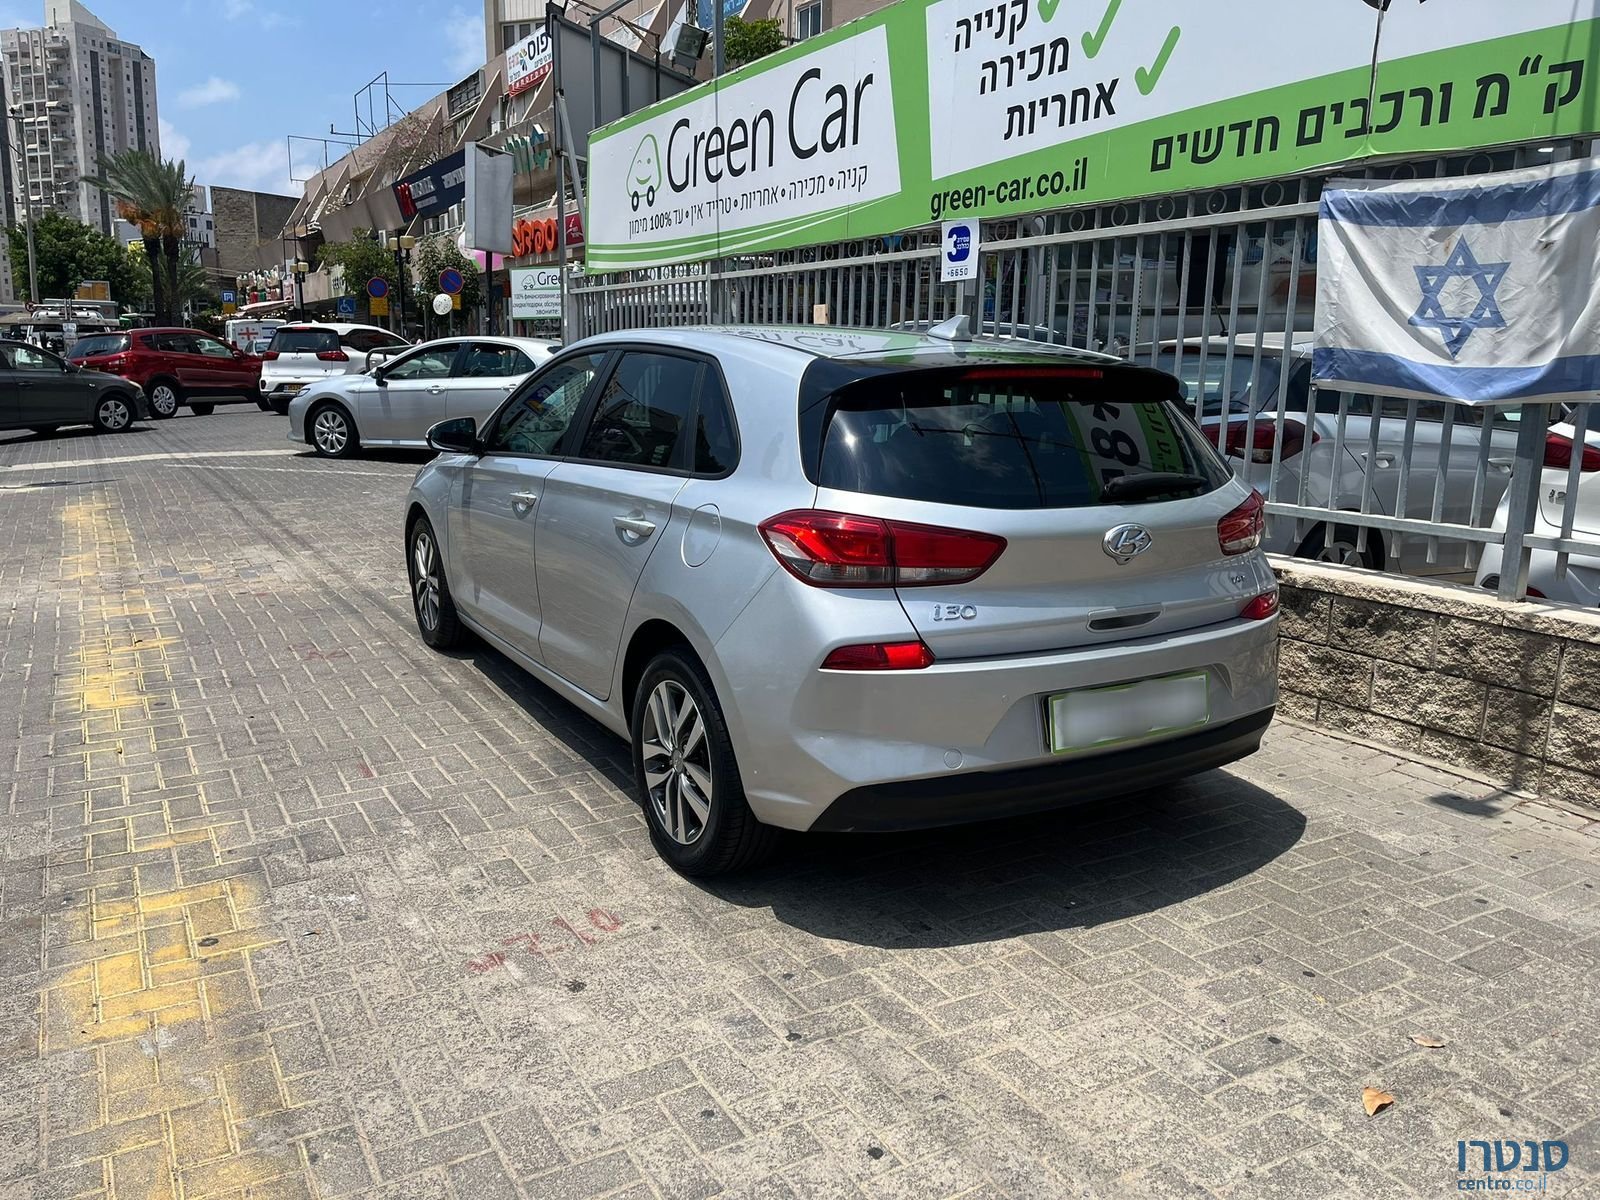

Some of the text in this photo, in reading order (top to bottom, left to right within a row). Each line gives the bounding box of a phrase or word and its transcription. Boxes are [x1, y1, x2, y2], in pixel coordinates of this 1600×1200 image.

[954, 0, 1028, 52] קנייה
[980, 37, 1069, 95] מכירה
[667, 67, 873, 193] Green Car
[1003, 78, 1119, 141] אחריות
[1296, 82, 1453, 148] ורכבים
[1150, 115, 1280, 172] חדשים
[629, 165, 867, 239] קניה מכירה אחריות טרייד אין עד 100% מימון
[930, 157, 1088, 220] green-car.co.il
